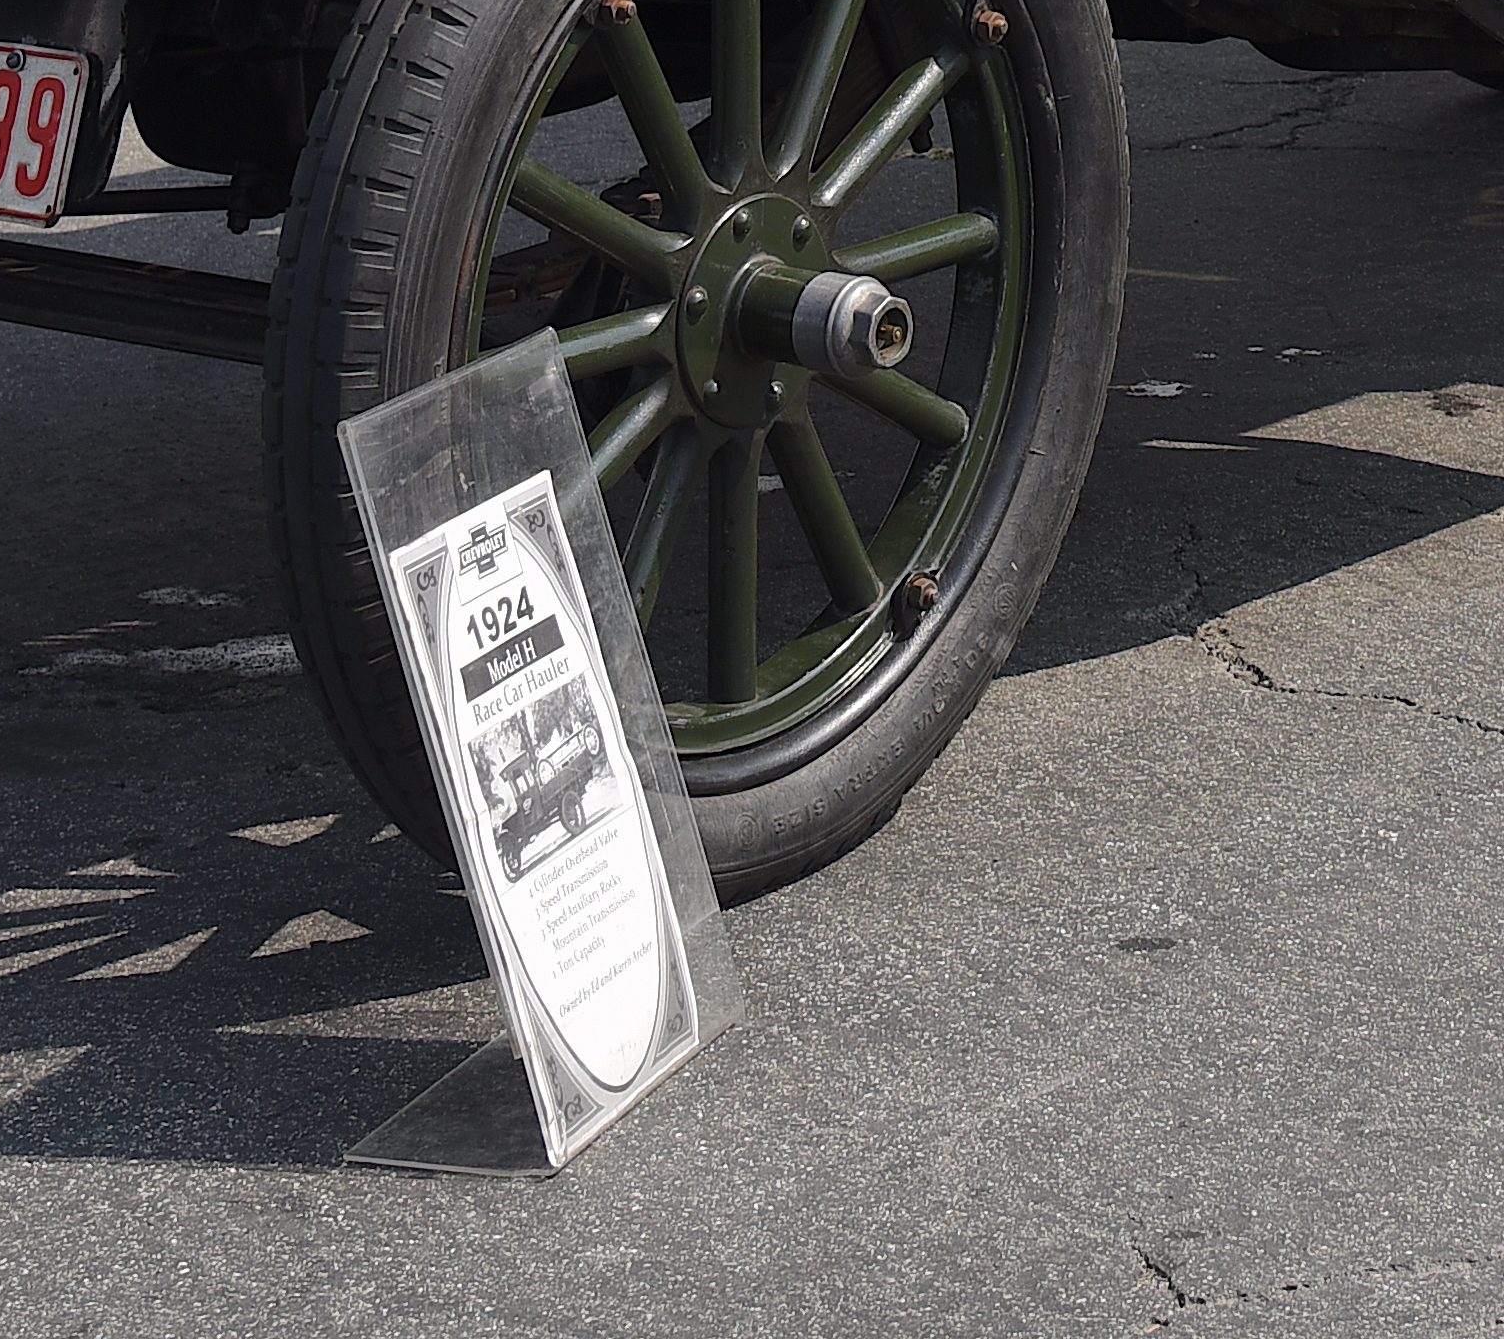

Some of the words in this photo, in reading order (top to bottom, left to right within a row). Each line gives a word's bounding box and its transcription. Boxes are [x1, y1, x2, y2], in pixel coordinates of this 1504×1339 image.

[460, 532, 503, 566] CHEVROLET
[465, 584, 535, 650] 1924
[486, 643, 524, 684] Model
[521, 636, 537, 662] H
[471, 697, 503, 726] Race
[502, 682, 523, 706] Car
[523, 656, 569, 694] Hauler
[772, 797, 827, 836] SIZE
[533, 865, 564, 893] Cylinder
[564, 837, 598, 870] Overhead
[597, 828, 618, 846] Valve
[539, 886, 561, 914] Speed
[560, 859, 608, 897] Transmission
[545, 907, 567, 934] Speed
[567, 890, 600, 916] Auxiliary
[598, 873, 621, 894] Rocky
[551, 921, 589, 950] Mountain
[586, 889, 635, 927] Transmission
[556, 957, 574, 973] Ton
[572, 936, 605, 962] Capacity
[558, 989, 582, 1017] Owned
[581, 987, 590, 1000] by
[590, 976, 599, 994] Ed
[600, 967, 612, 987] and
[612, 957, 631, 977] Karen
[632, 940, 652, 959] Archer
